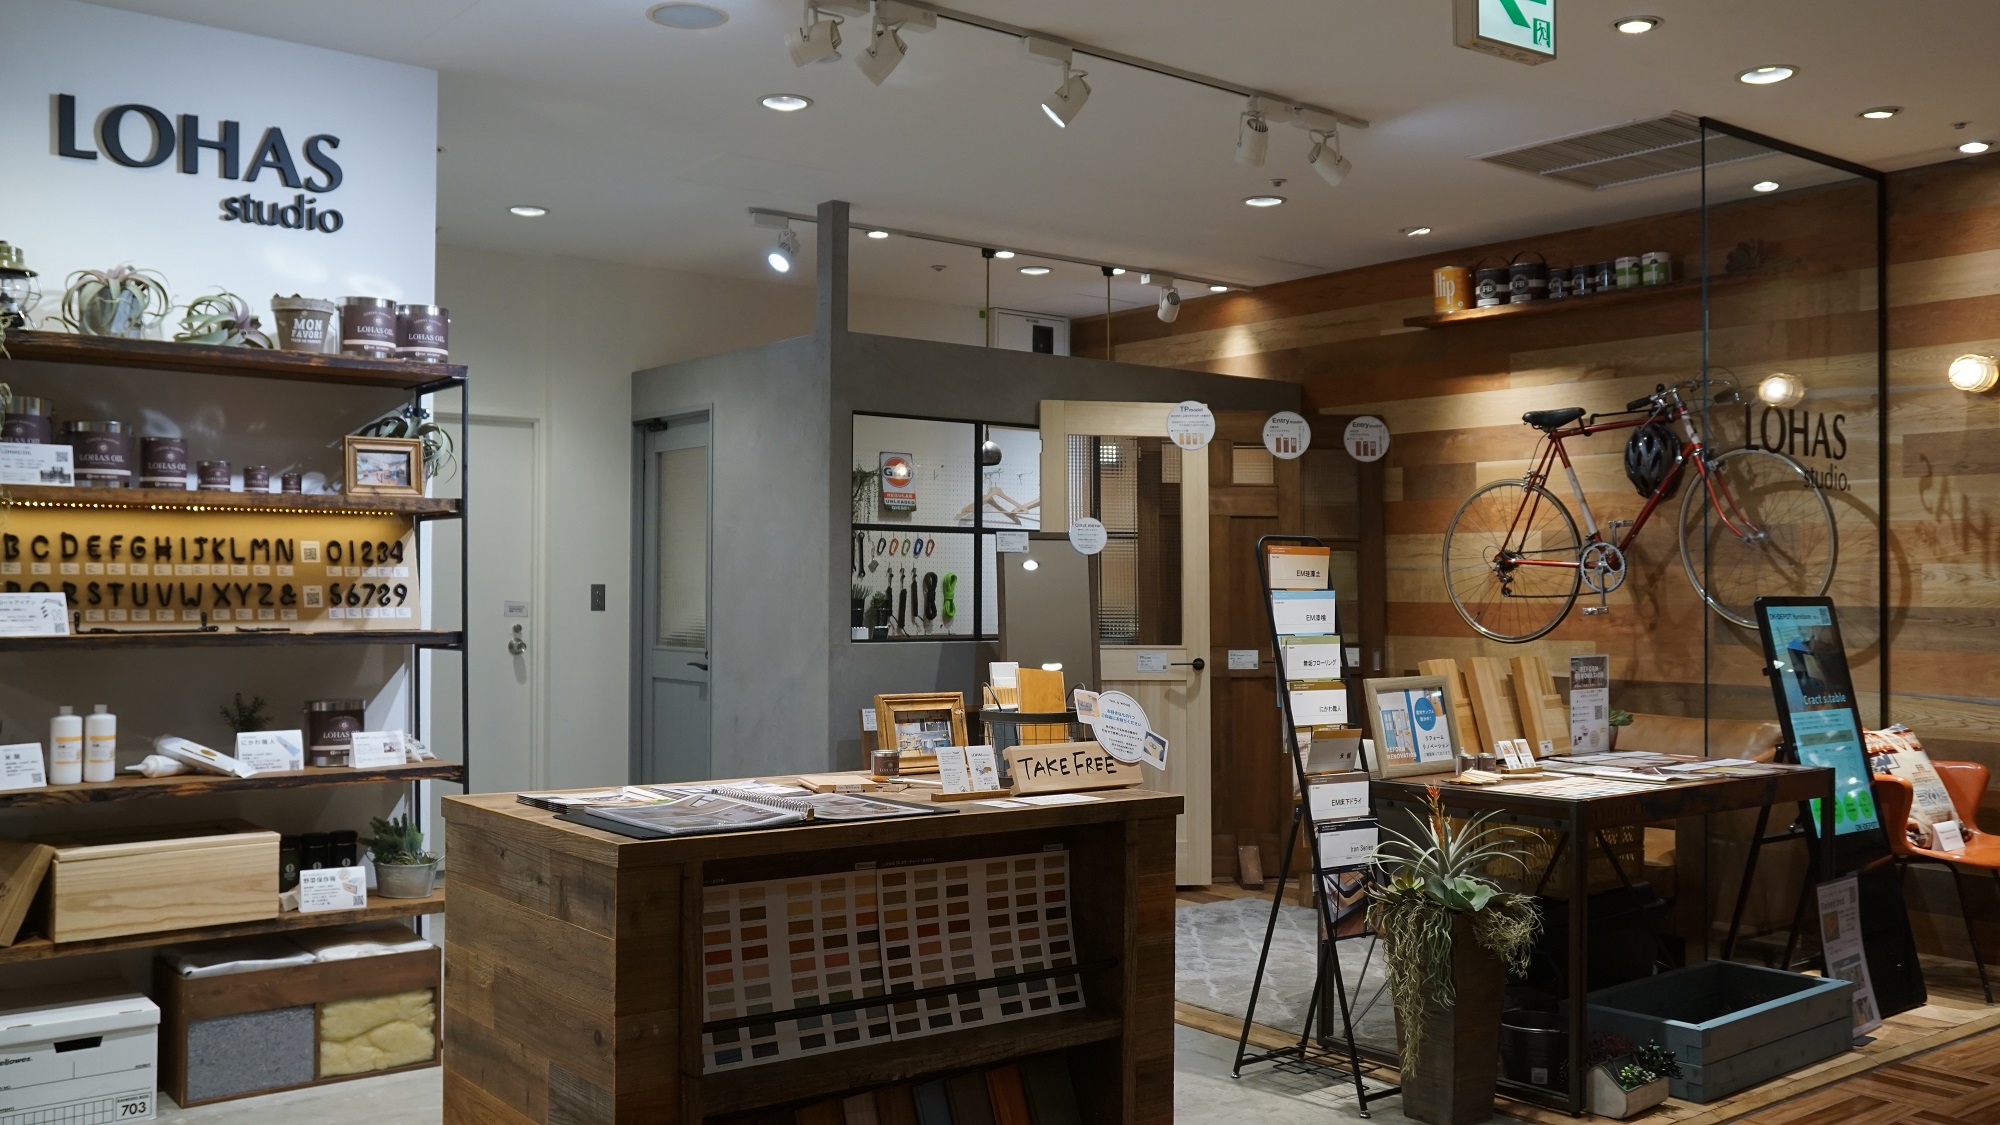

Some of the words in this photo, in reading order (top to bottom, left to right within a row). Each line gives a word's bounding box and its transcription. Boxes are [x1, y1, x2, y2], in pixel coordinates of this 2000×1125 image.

[56, 93, 344, 194] LOHAS
[221, 193, 344, 234] studio
[293, 318, 323, 331] MON
[291, 329, 323, 339] FAVORI
[357, 325, 384, 334] LOHAS
[384, 328, 394, 337] OIL
[408, 333, 434, 342] LOHAS
[434, 335, 445, 344] OIL
[1745, 403, 1847, 461] LOHAS
[78, 453, 109, 463] LOHAS
[1303, 658, 1337, 667] 無垢フローリング
[1580, 665, 1599, 673] REFORM
[323, 730, 350, 739] LOHAS
[240, 738, 275, 746] にかわ職人
[1017, 756, 1071, 780] TAKE
[1071, 751, 1117, 776] FREE
[1350, 845, 1359, 853] Iron
[1360, 844, 1374, 852] Series
[121, 1101, 147, 1117] 703
